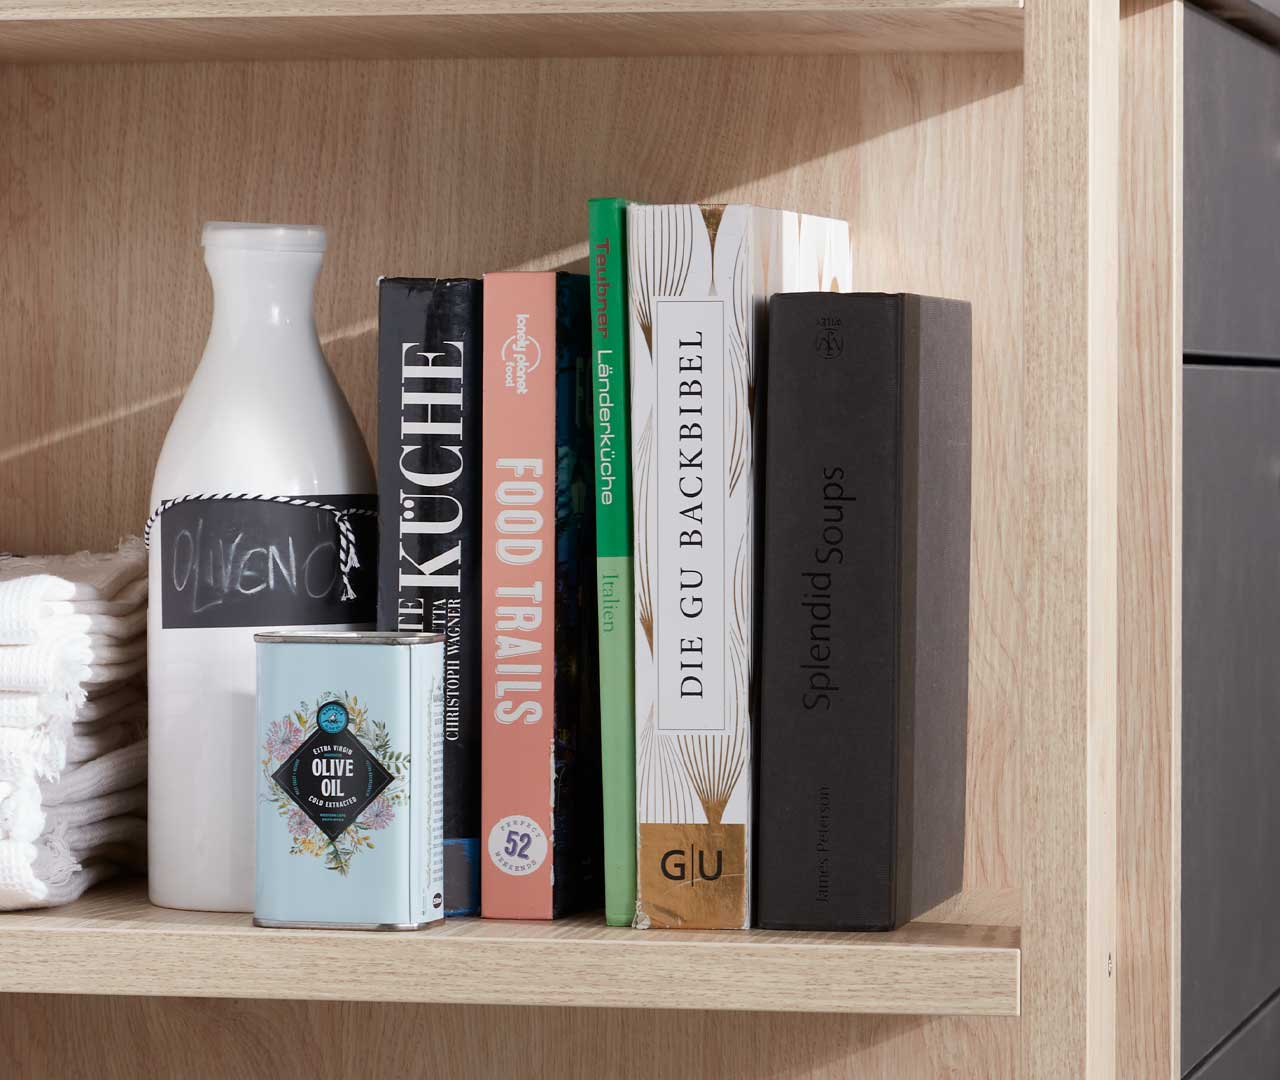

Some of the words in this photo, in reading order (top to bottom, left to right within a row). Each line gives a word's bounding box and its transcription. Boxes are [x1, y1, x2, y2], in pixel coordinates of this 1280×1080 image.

[595, 237, 611, 339] Teubner
[512, 313, 530, 352] lonely
[504, 361, 516, 387] food
[512, 353, 530, 395] planet
[597, 349, 617, 506] Länderküche
[678, 330, 704, 549] BACKBIBEL
[398, 341, 464, 593] KÜCHE
[494, 457, 545, 566] FOOD
[815, 466, 857, 565] Soups
[398, 598, 425, 633] TE
[602, 573, 621, 633] Italien
[679, 567, 704, 619] GU
[446, 598, 462, 656] WAGNER
[493, 580, 544, 726] TRAILS
[800, 572, 841, 711] Splendid
[679, 636, 704, 700] DIE
[445, 659, 461, 742] CHRISTOPH
[311, 758, 355, 778] OLIVE
[312, 745, 332, 756] EXTRA
[333, 745, 354, 756] VIRGIN
[307, 795, 324, 808] COLD
[324, 795, 358, 809] EXTRACTED
[320, 778, 346, 798] OIL
[499, 819, 542, 840] PERFECT
[503, 829, 532, 862] 52
[815, 784, 832, 852] Peterson
[495, 850, 537, 872] WEEKENDS
[815, 857, 831, 904] James
